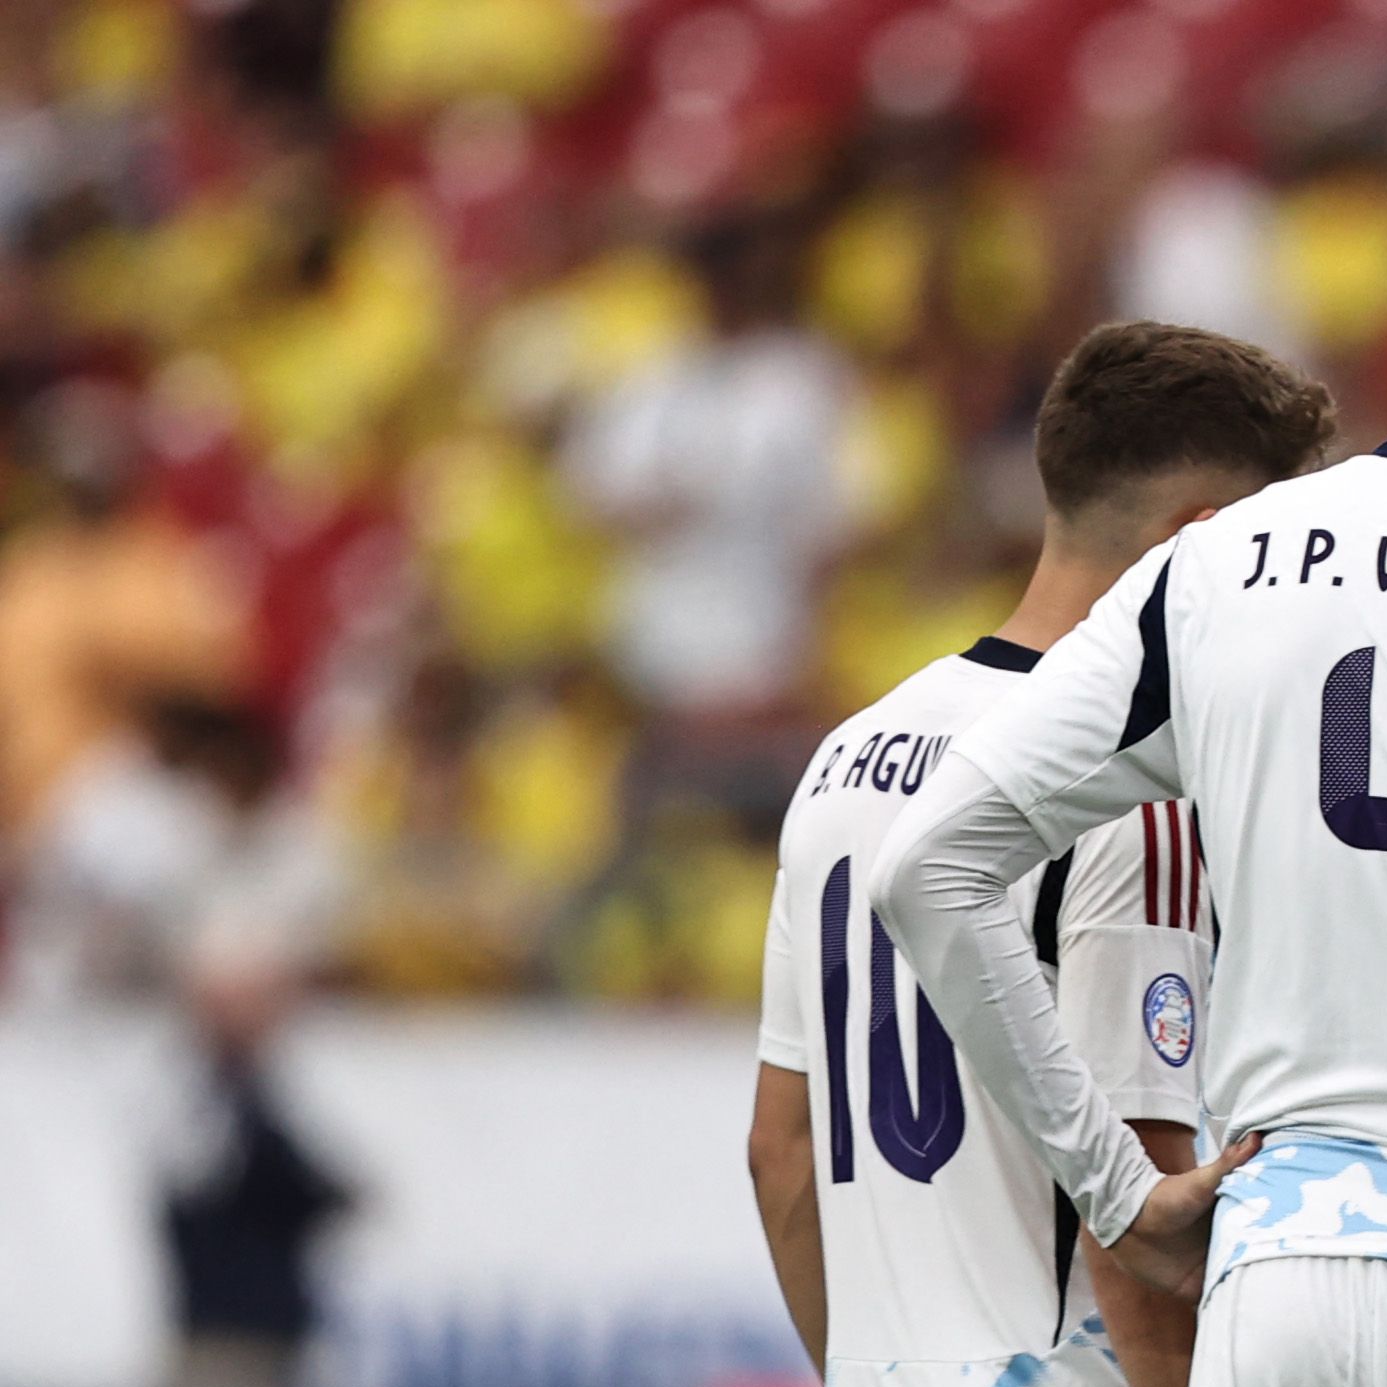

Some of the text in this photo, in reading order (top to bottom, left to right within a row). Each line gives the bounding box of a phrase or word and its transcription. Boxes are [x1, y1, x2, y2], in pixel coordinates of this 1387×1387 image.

[1243, 533, 1276, 590] J.
[1300, 529, 1343, 587] P.
[822, 855, 965, 1184] 10
